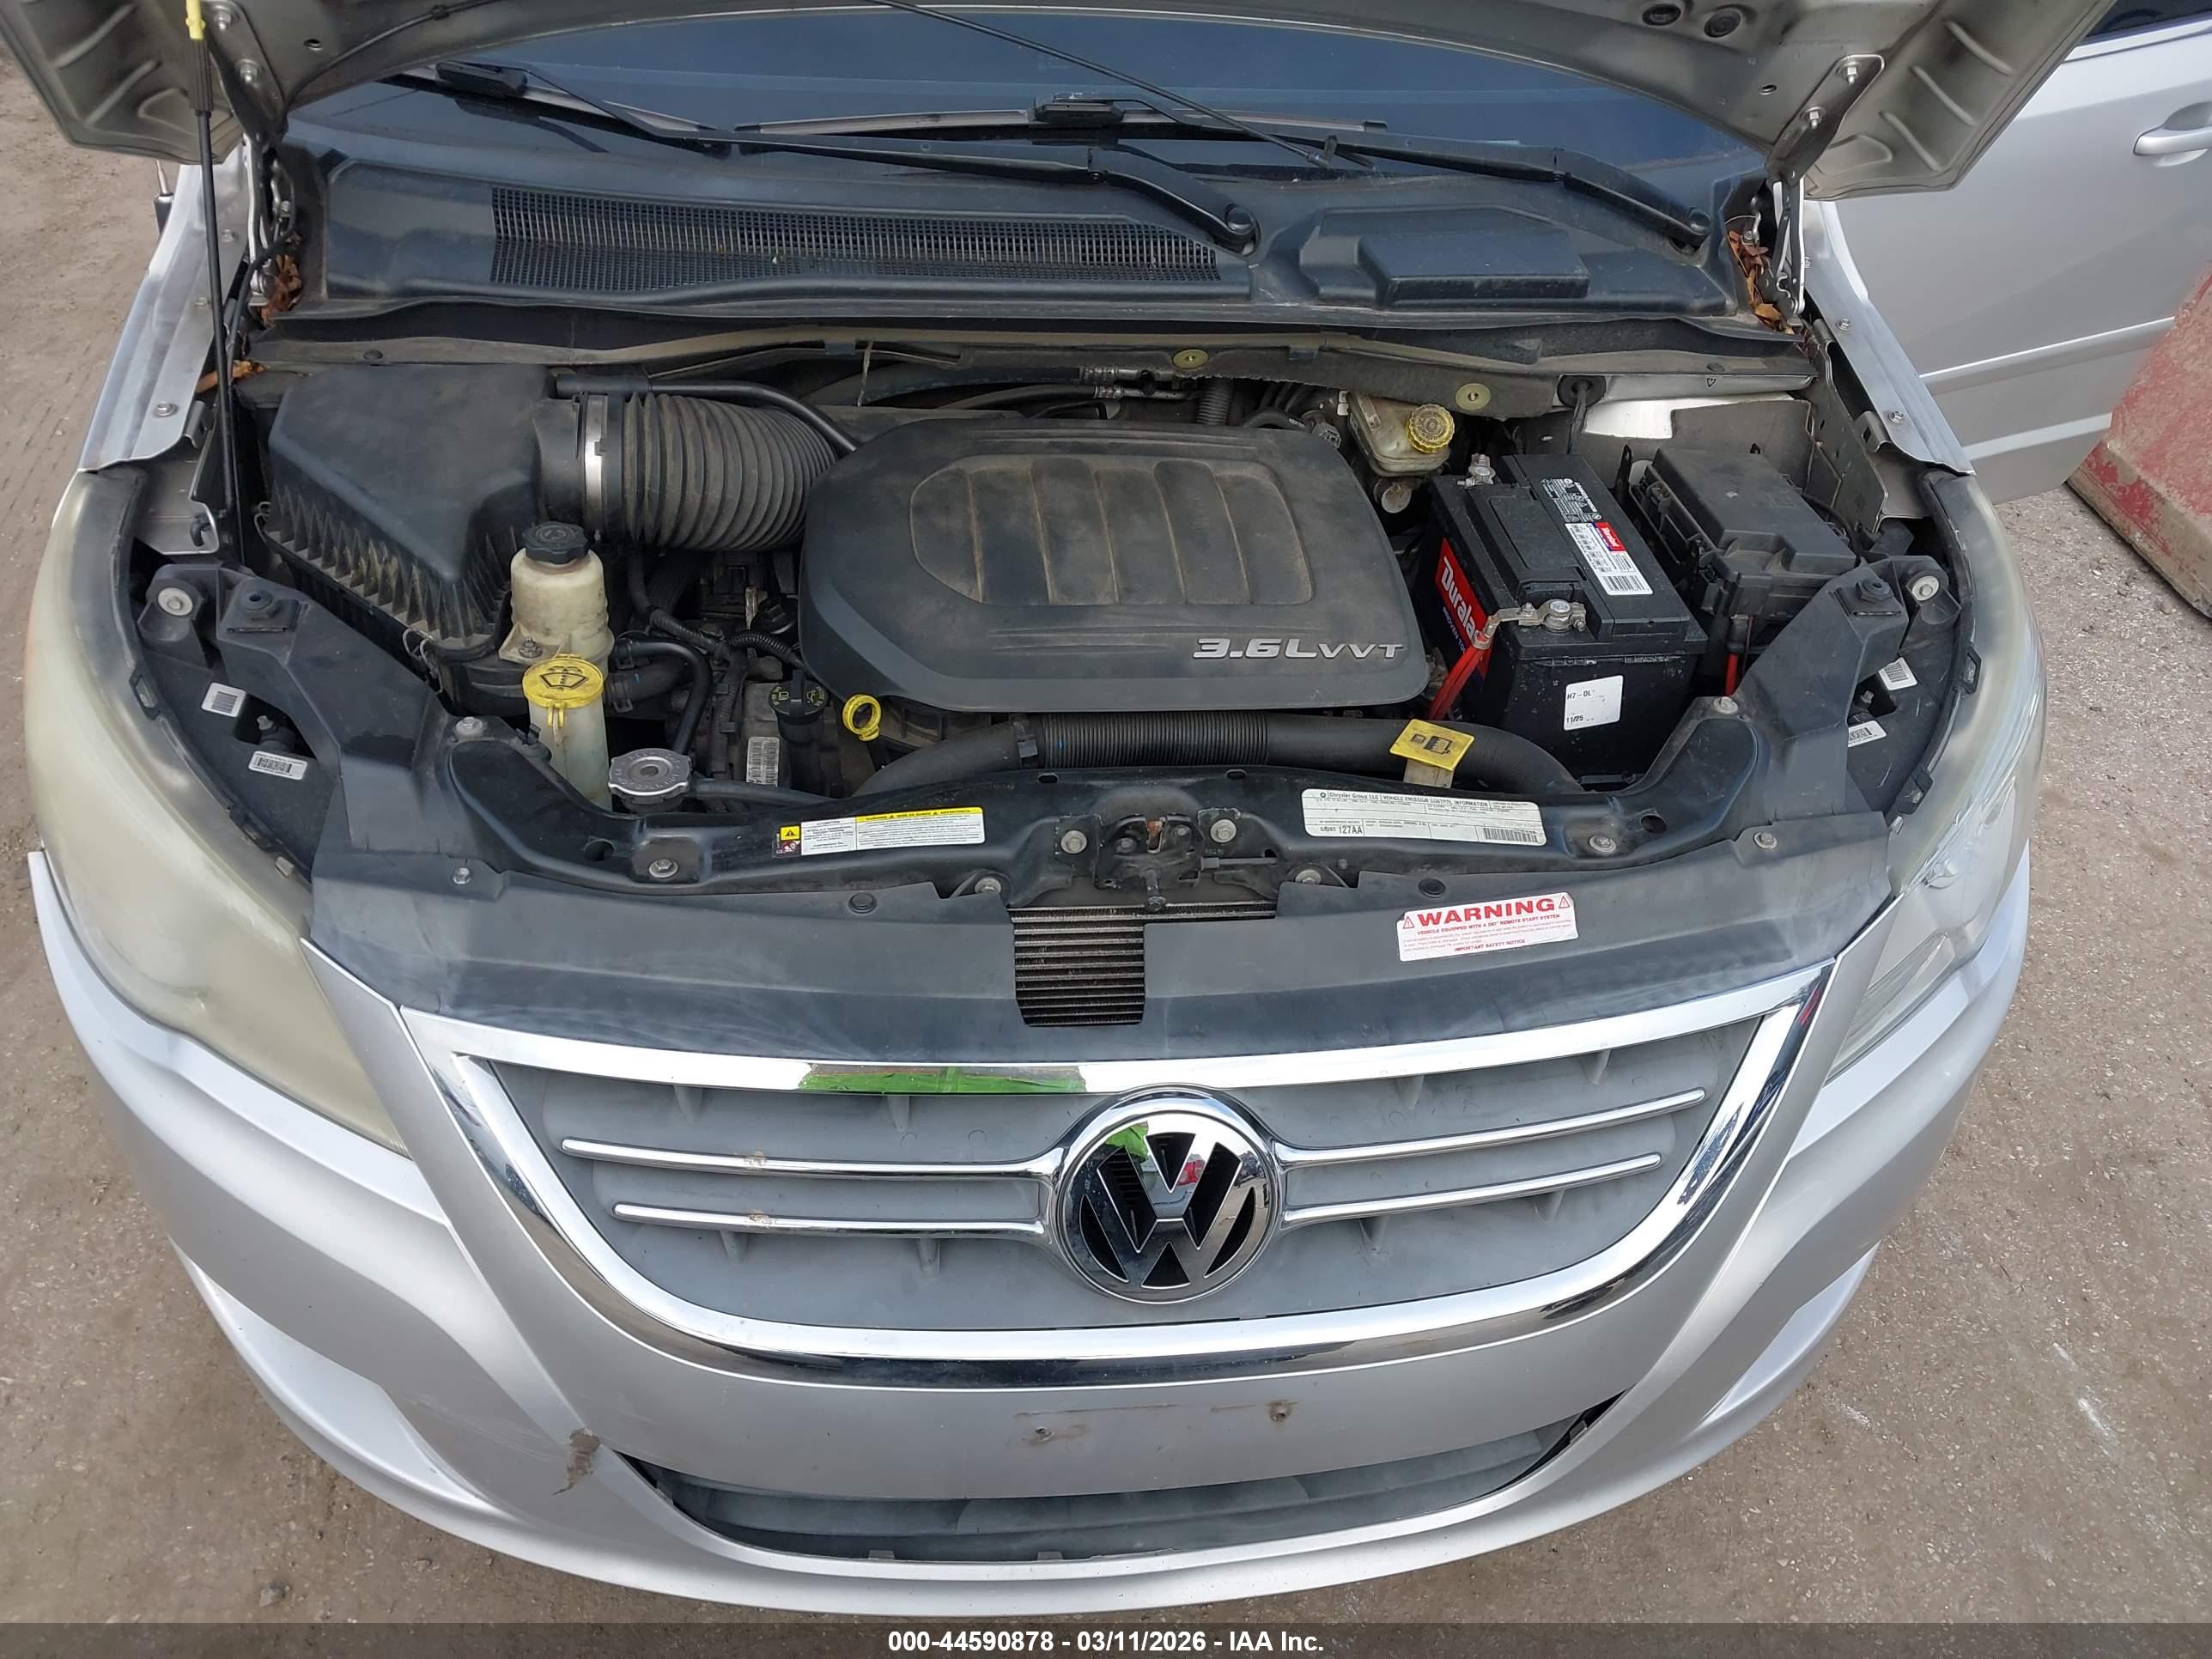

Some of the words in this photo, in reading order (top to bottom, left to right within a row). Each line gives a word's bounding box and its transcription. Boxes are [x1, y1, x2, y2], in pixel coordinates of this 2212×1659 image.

[1441, 556, 1476, 642] Durala
[1329, 791, 1352, 799] Chrysler
[1454, 799, 1489, 808] INFORMATION
[1339, 825, 1363, 835] 127AA
[1417, 897, 1555, 927] WARNING
[1441, 925, 1468, 934] EQUIPPED
[1540, 913, 1560, 921] SYSTEM
[1454, 944, 1485, 953] IMPORTANT
